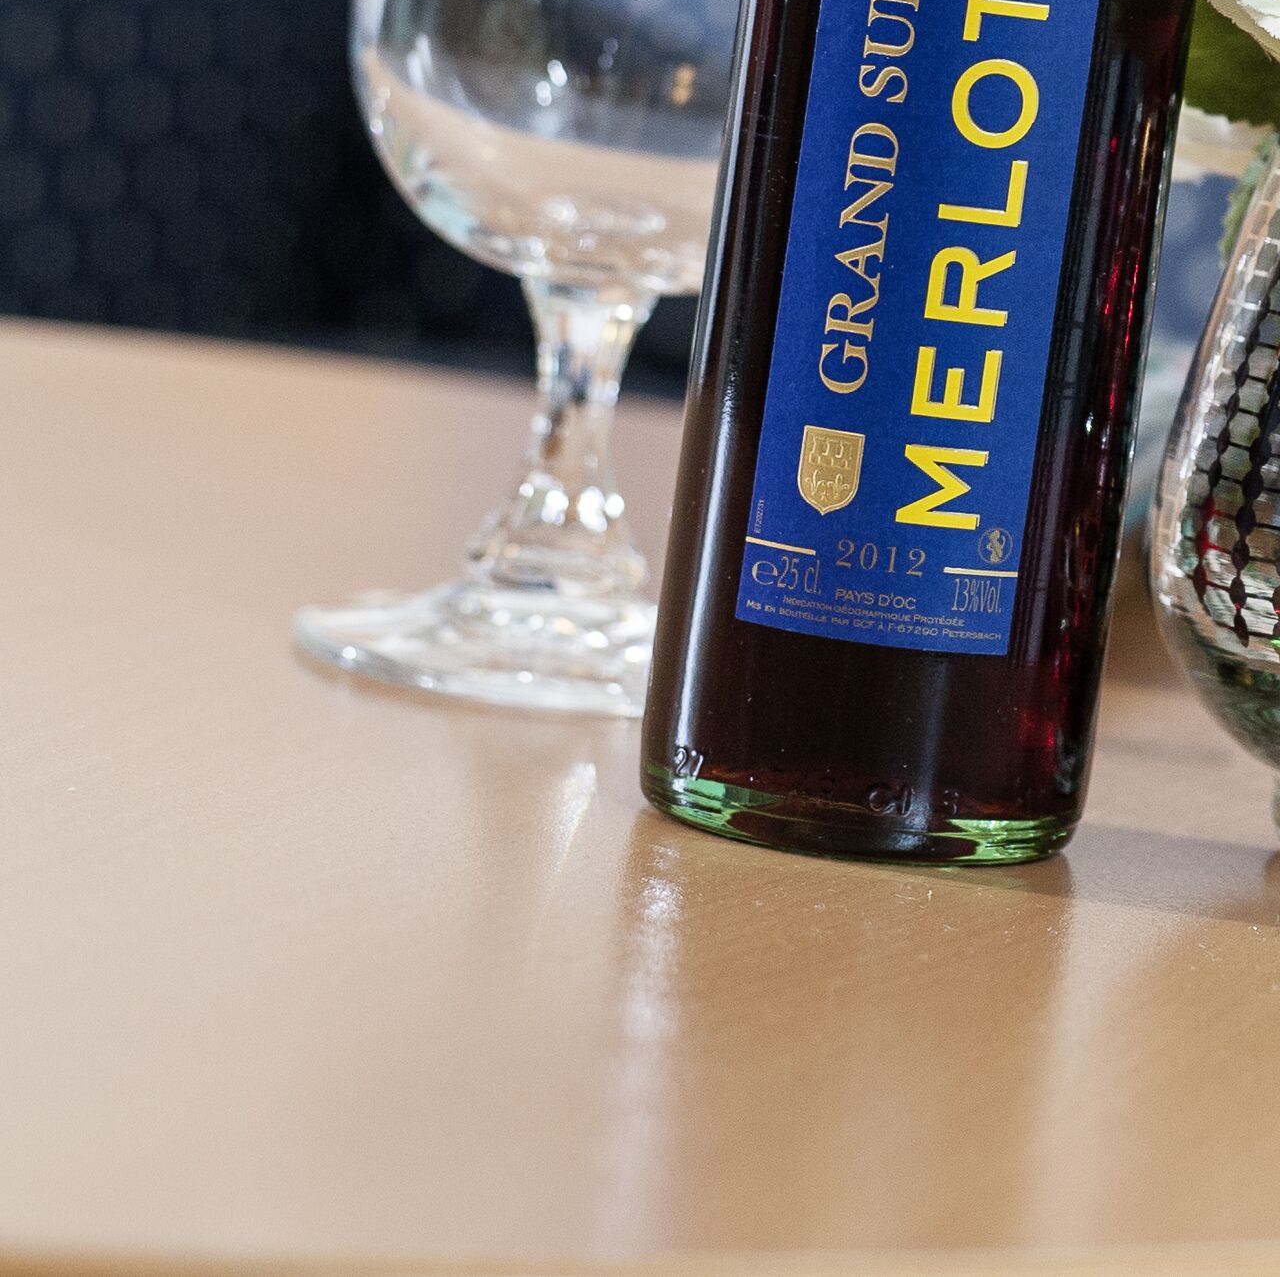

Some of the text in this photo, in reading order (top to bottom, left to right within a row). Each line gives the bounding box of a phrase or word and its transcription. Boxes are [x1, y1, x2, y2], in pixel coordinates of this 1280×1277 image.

[819, 122, 899, 395] GRAND
[835, 539, 926, 577] 2012
[746, 599, 762, 610] MIS
[783, 595, 832, 611] INDICATION
[835, 587, 917, 610] PAYS D'OC
